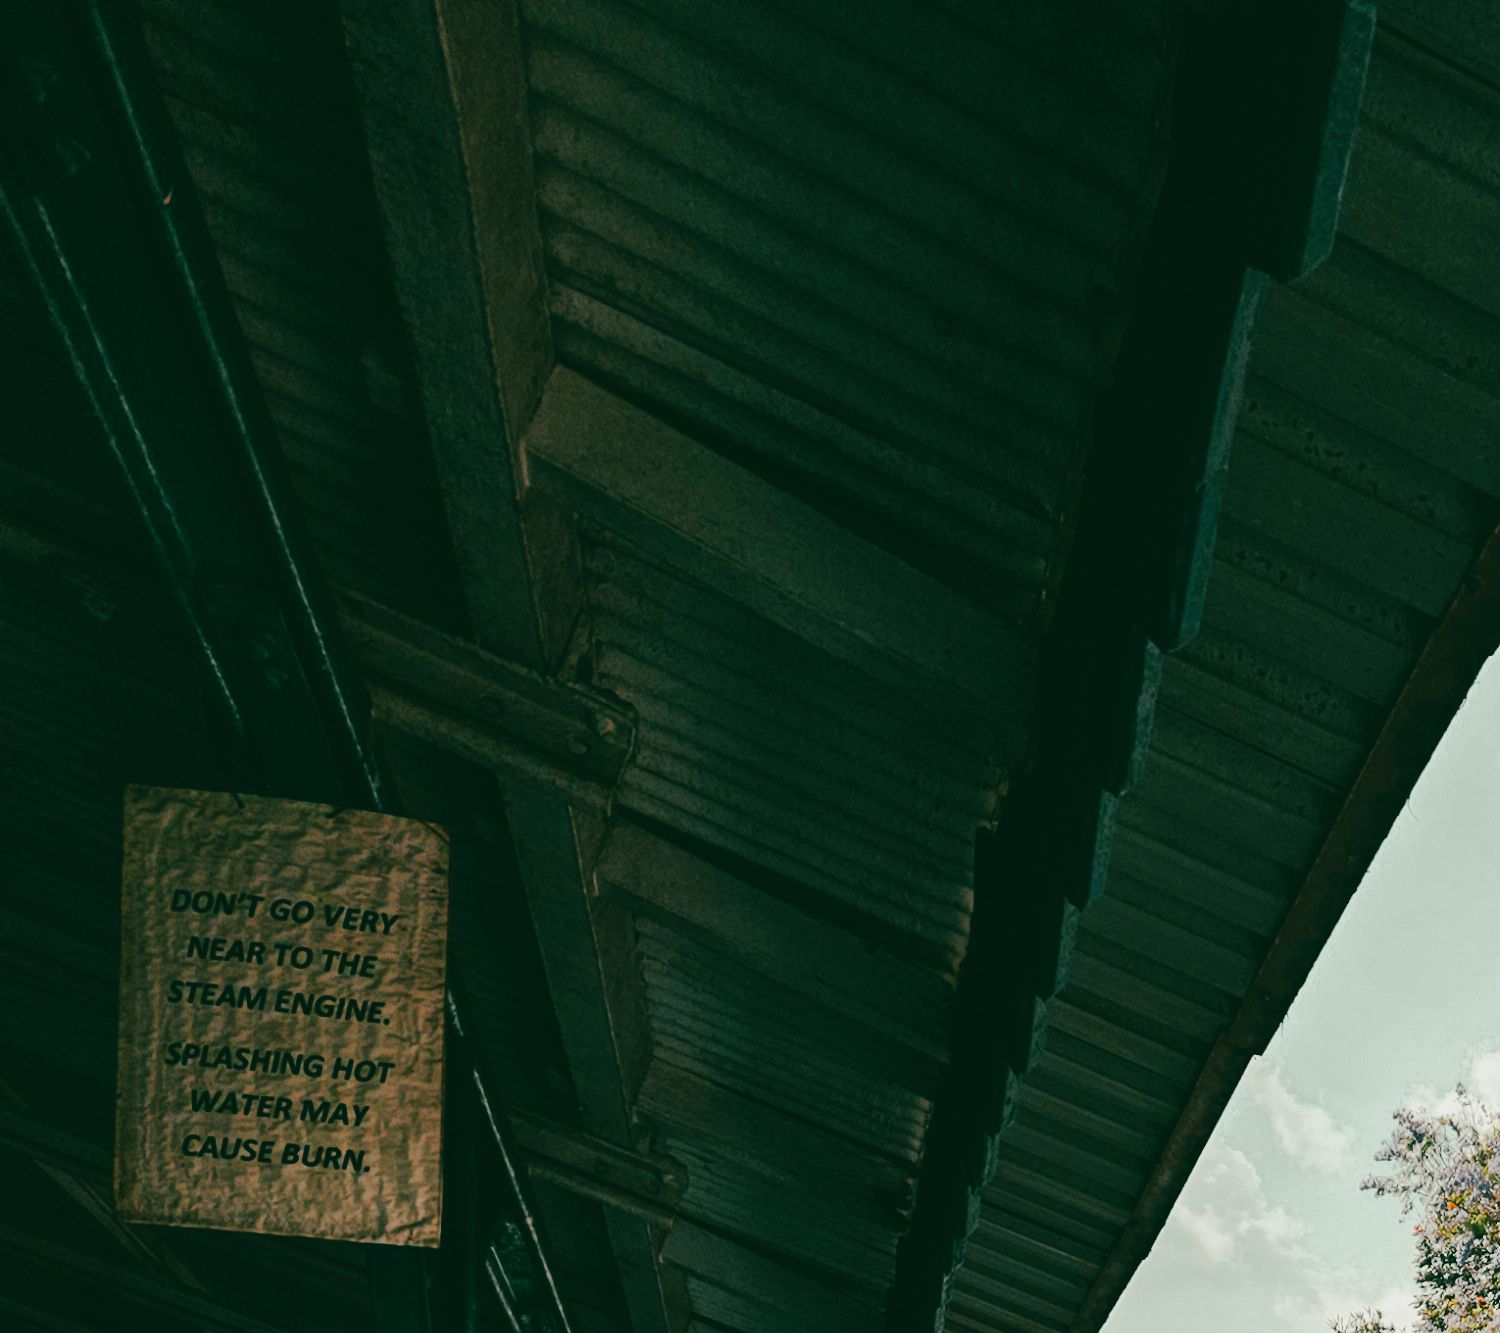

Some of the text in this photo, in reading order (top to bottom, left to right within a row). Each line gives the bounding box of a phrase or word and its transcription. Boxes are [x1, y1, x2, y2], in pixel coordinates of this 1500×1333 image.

[170, 889, 399, 935] DON'T GO VERY
[187, 935, 379, 979] NEAR TO THE
[168, 980, 391, 1026] STEAM ENGINE.
[164, 1041, 396, 1084] SPLASHING HOT
[191, 1089, 371, 1128] WATER MAY
[181, 1134, 371, 1173] CAUSE BURN.
